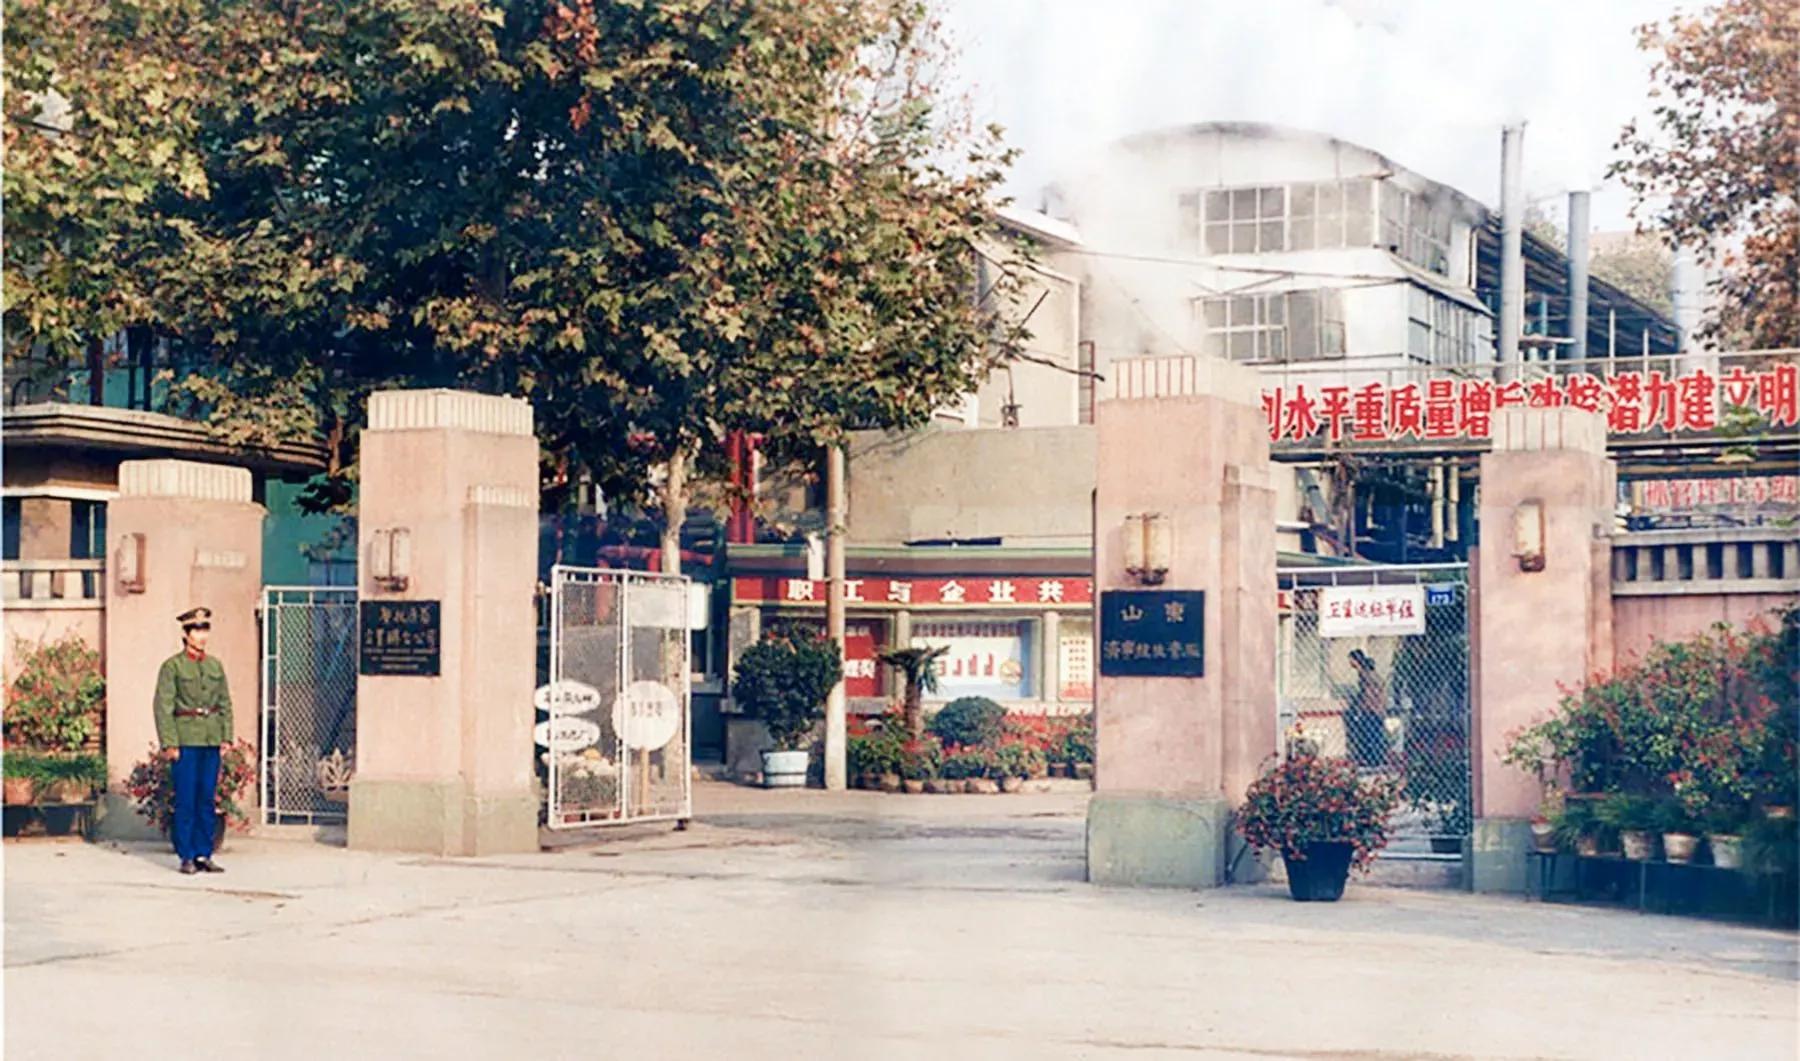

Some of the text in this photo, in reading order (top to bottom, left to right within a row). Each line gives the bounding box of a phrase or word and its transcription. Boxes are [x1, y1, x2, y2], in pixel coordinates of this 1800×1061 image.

[787, 579, 1093, 604] 职工与企业共
